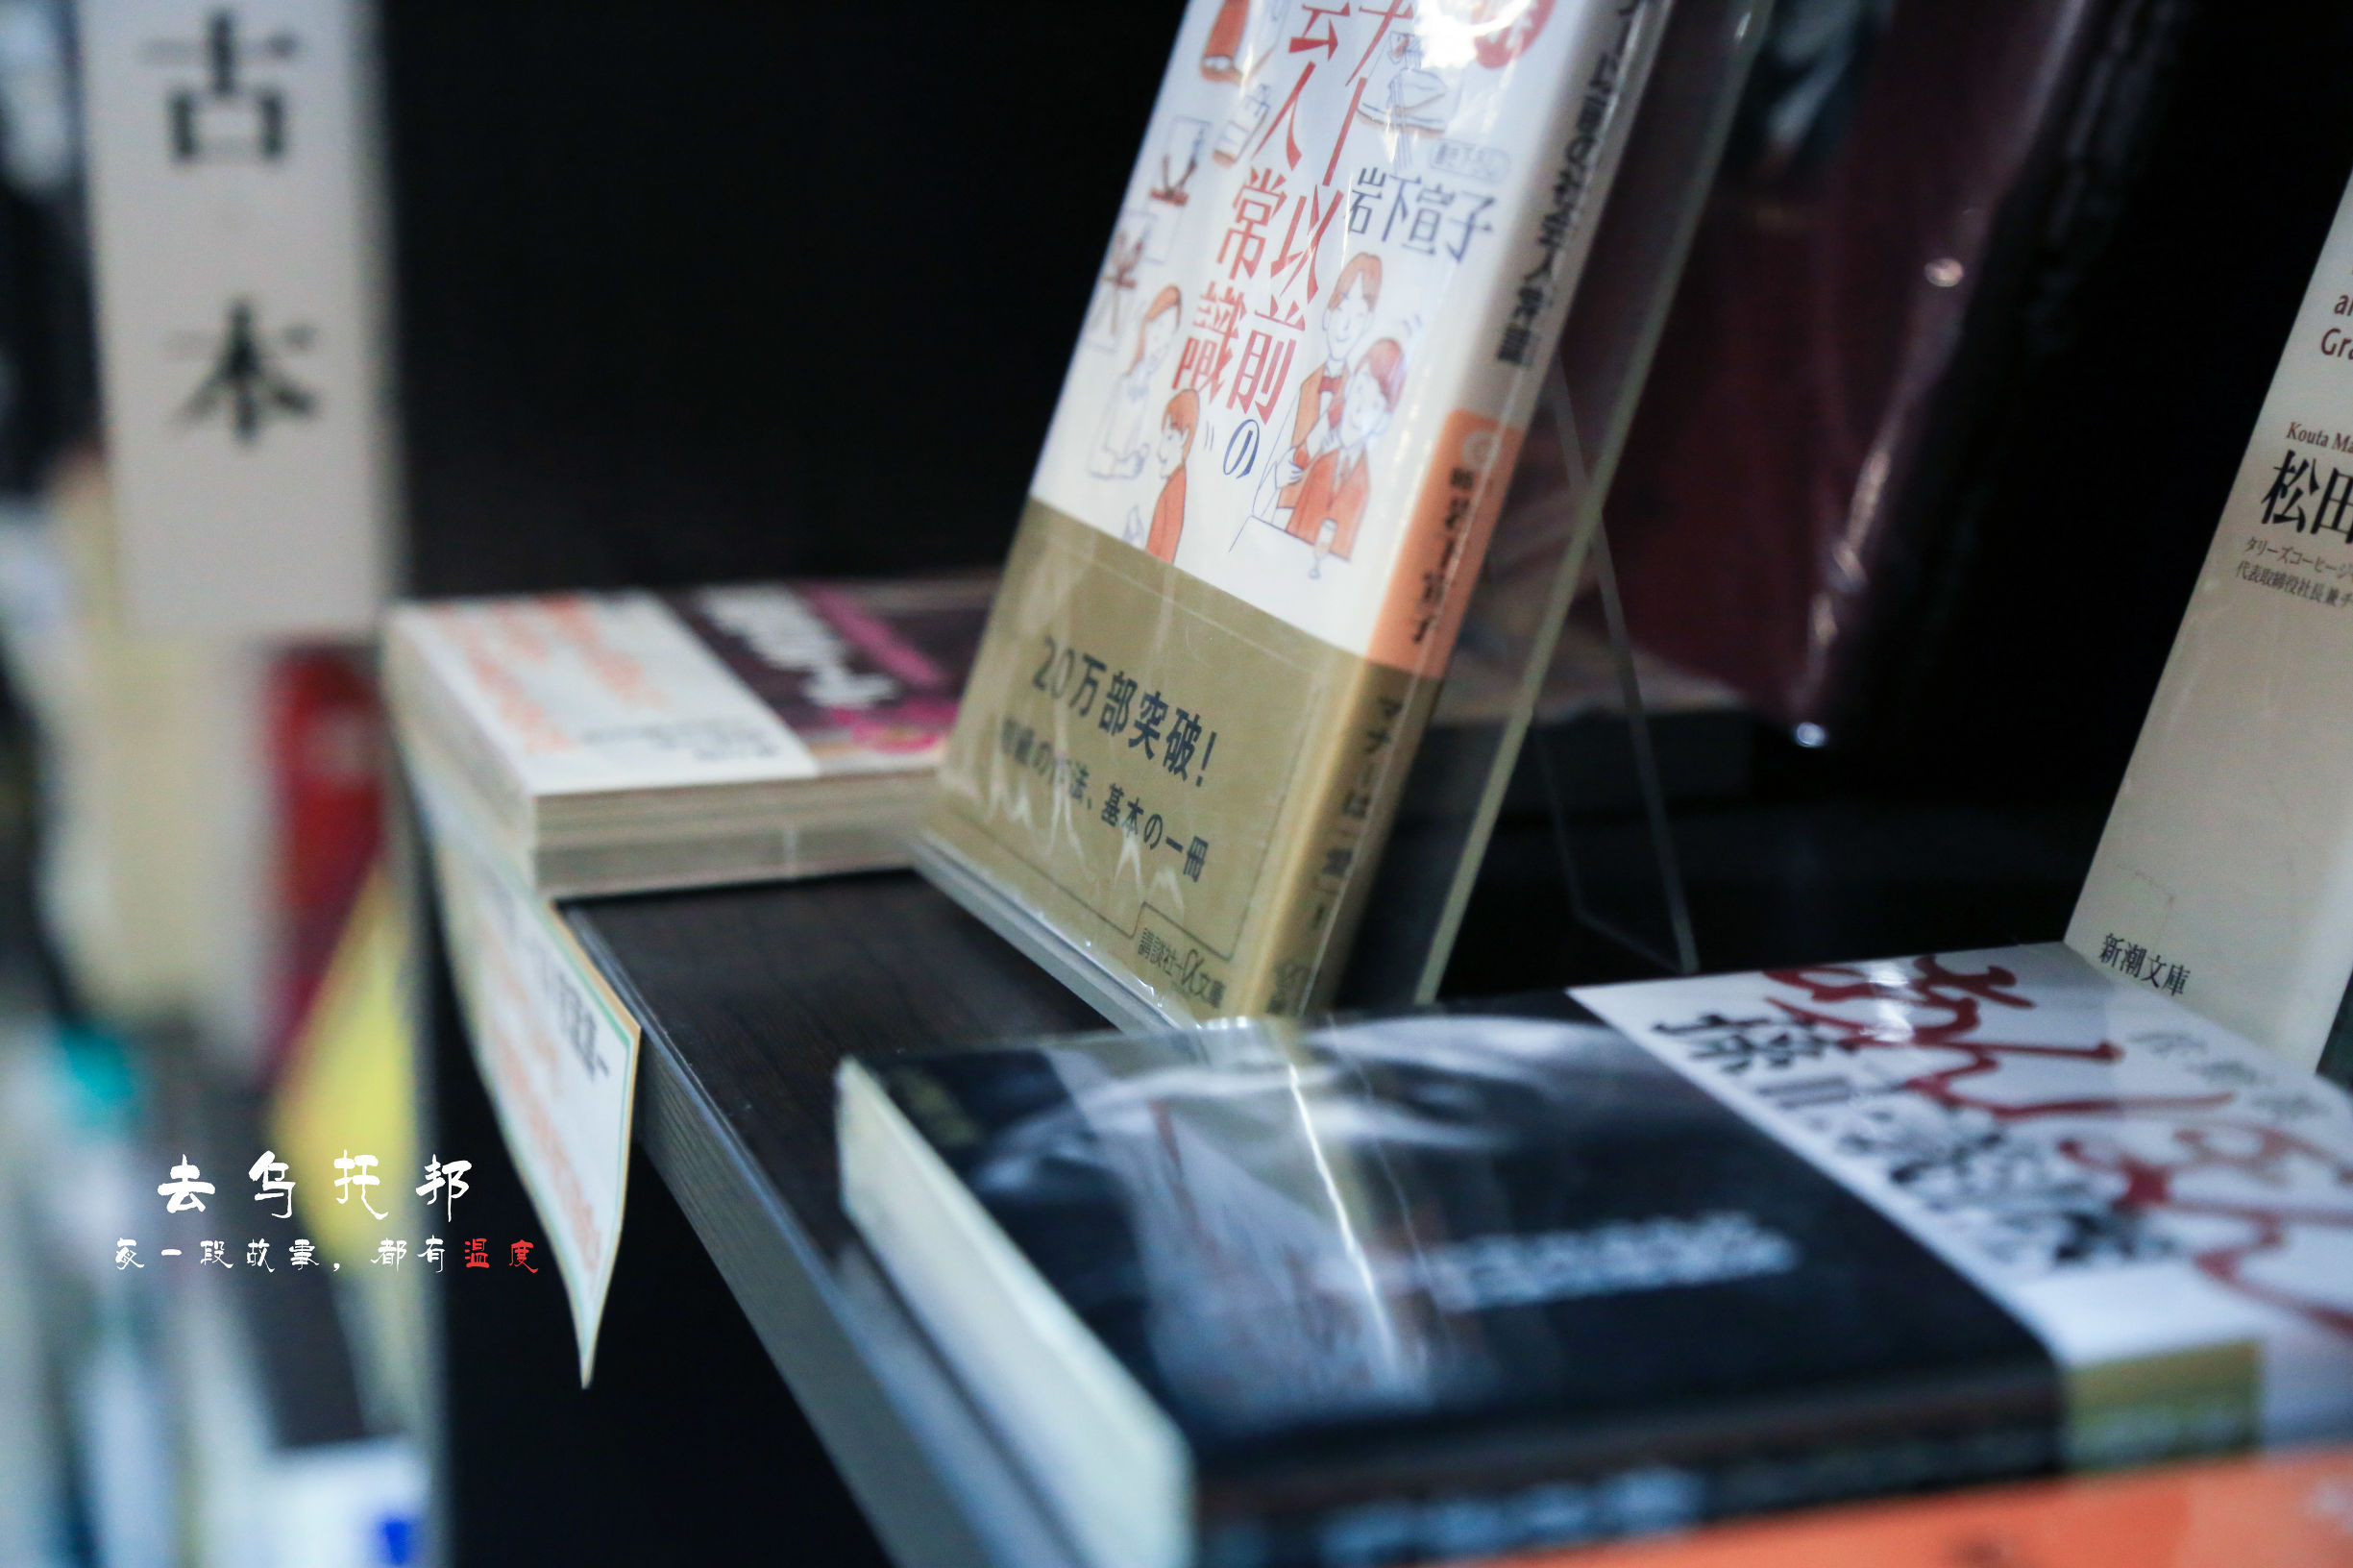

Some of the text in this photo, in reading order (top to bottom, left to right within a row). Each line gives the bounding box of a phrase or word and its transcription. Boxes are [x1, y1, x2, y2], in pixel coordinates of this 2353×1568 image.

[142, 8, 321, 448] 古本
[1344, 166, 1496, 263] 岩下宣子
[2286, 421, 2330, 448] Kouta
[2261, 449, 2353, 544] 松田
[1032, 634, 1218, 789] 20万部突破！
[2098, 932, 2191, 997] 新潮文庫
